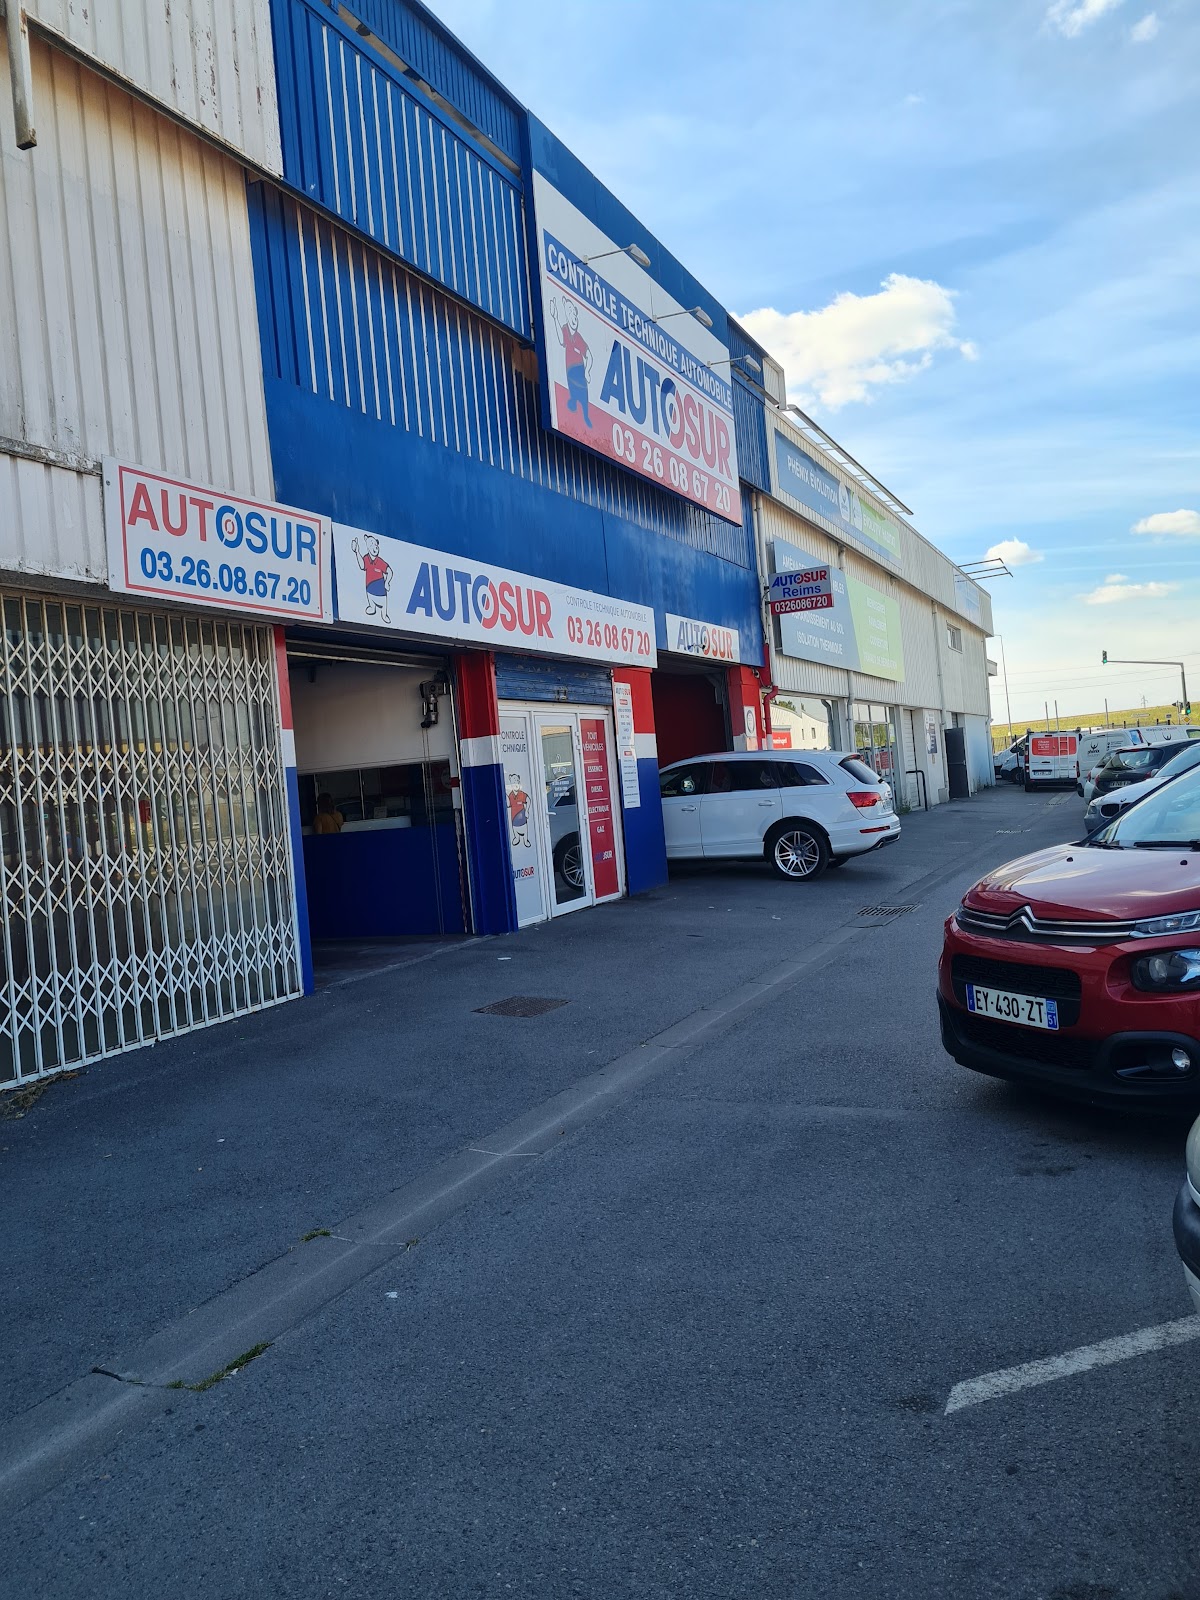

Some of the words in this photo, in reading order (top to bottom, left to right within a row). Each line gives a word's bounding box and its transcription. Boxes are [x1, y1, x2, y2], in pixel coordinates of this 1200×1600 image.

[548, 243, 618, 320] CONTRÔLE
[620, 302, 679, 368] TECHNIQUE
[680, 359, 732, 410] AUTOMOBILE
[600, 339, 733, 481] AUTOSUR
[612, 423, 636, 464] 03
[641, 440, 664, 478] 26
[669, 458, 688, 491] 08
[692, 470, 709, 502] 67
[715, 486, 731, 513] 20
[127, 482, 317, 565] AUTOSUR
[140, 547, 311, 605] 03.26.08.67.20
[772, 569, 827, 588] AUTOSUR
[782, 585, 821, 598] Reims
[405, 561, 554, 639] AUTOSUR
[593, 601, 620, 617] TECHNIQUE
[620, 608, 647, 622] AUTOMOBILE
[774, 595, 828, 613] 0326086720
[567, 615, 584, 644] 03
[585, 619, 602, 647] 26
[604, 623, 619, 650] 08
[621, 627, 634, 653] 67
[636, 630, 651, 656] 20
[676, 620, 734, 660] AUTOSUR
[501, 730, 525, 740] ONTROLE
[587, 765, 603, 773] ESSENCE
[591, 785, 603, 793] DIESEL
[975, 989, 1044, 1023] EY-430-ZT
[1048, 1014, 1057, 1026] 51
